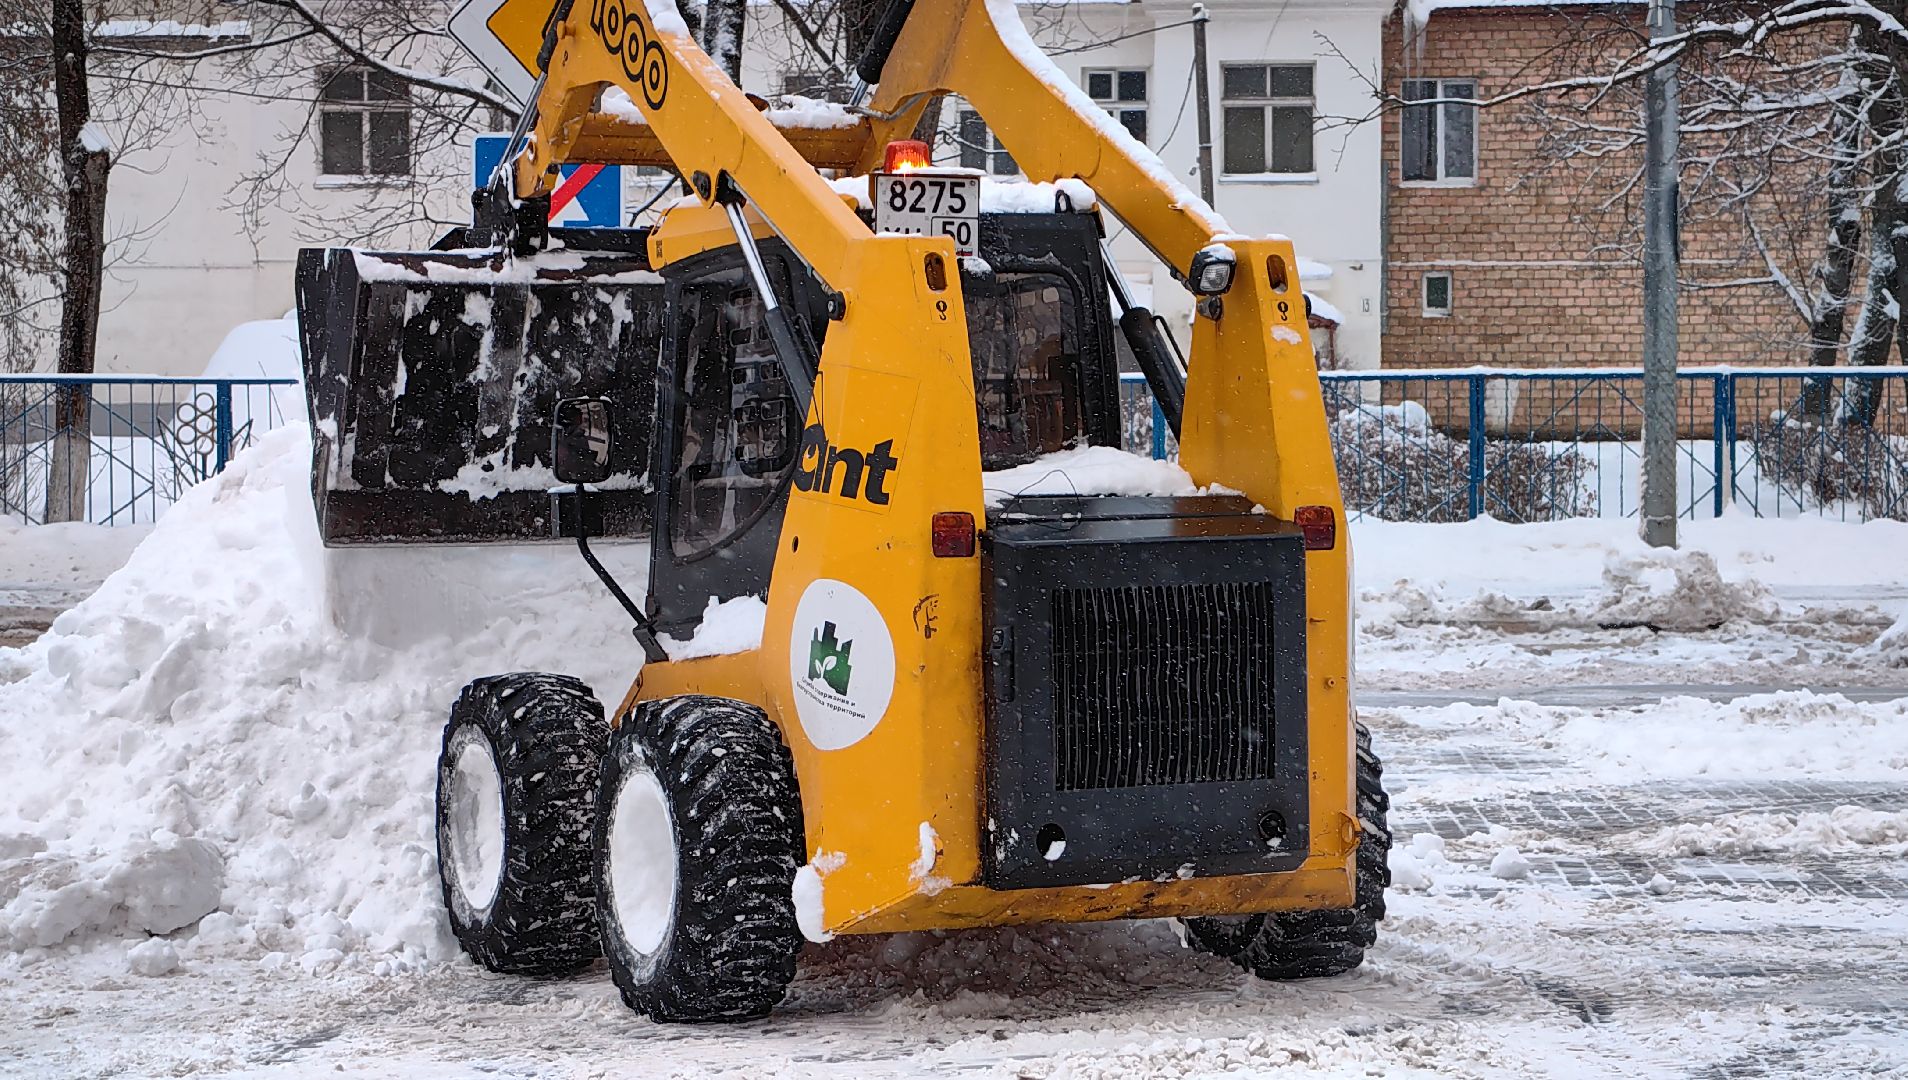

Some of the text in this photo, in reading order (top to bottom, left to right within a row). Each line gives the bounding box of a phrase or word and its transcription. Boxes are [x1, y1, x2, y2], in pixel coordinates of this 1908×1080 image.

[889, 180, 966, 214] 8275
[942, 221, 971, 246] 50
[826, 702, 866, 719] территорий
